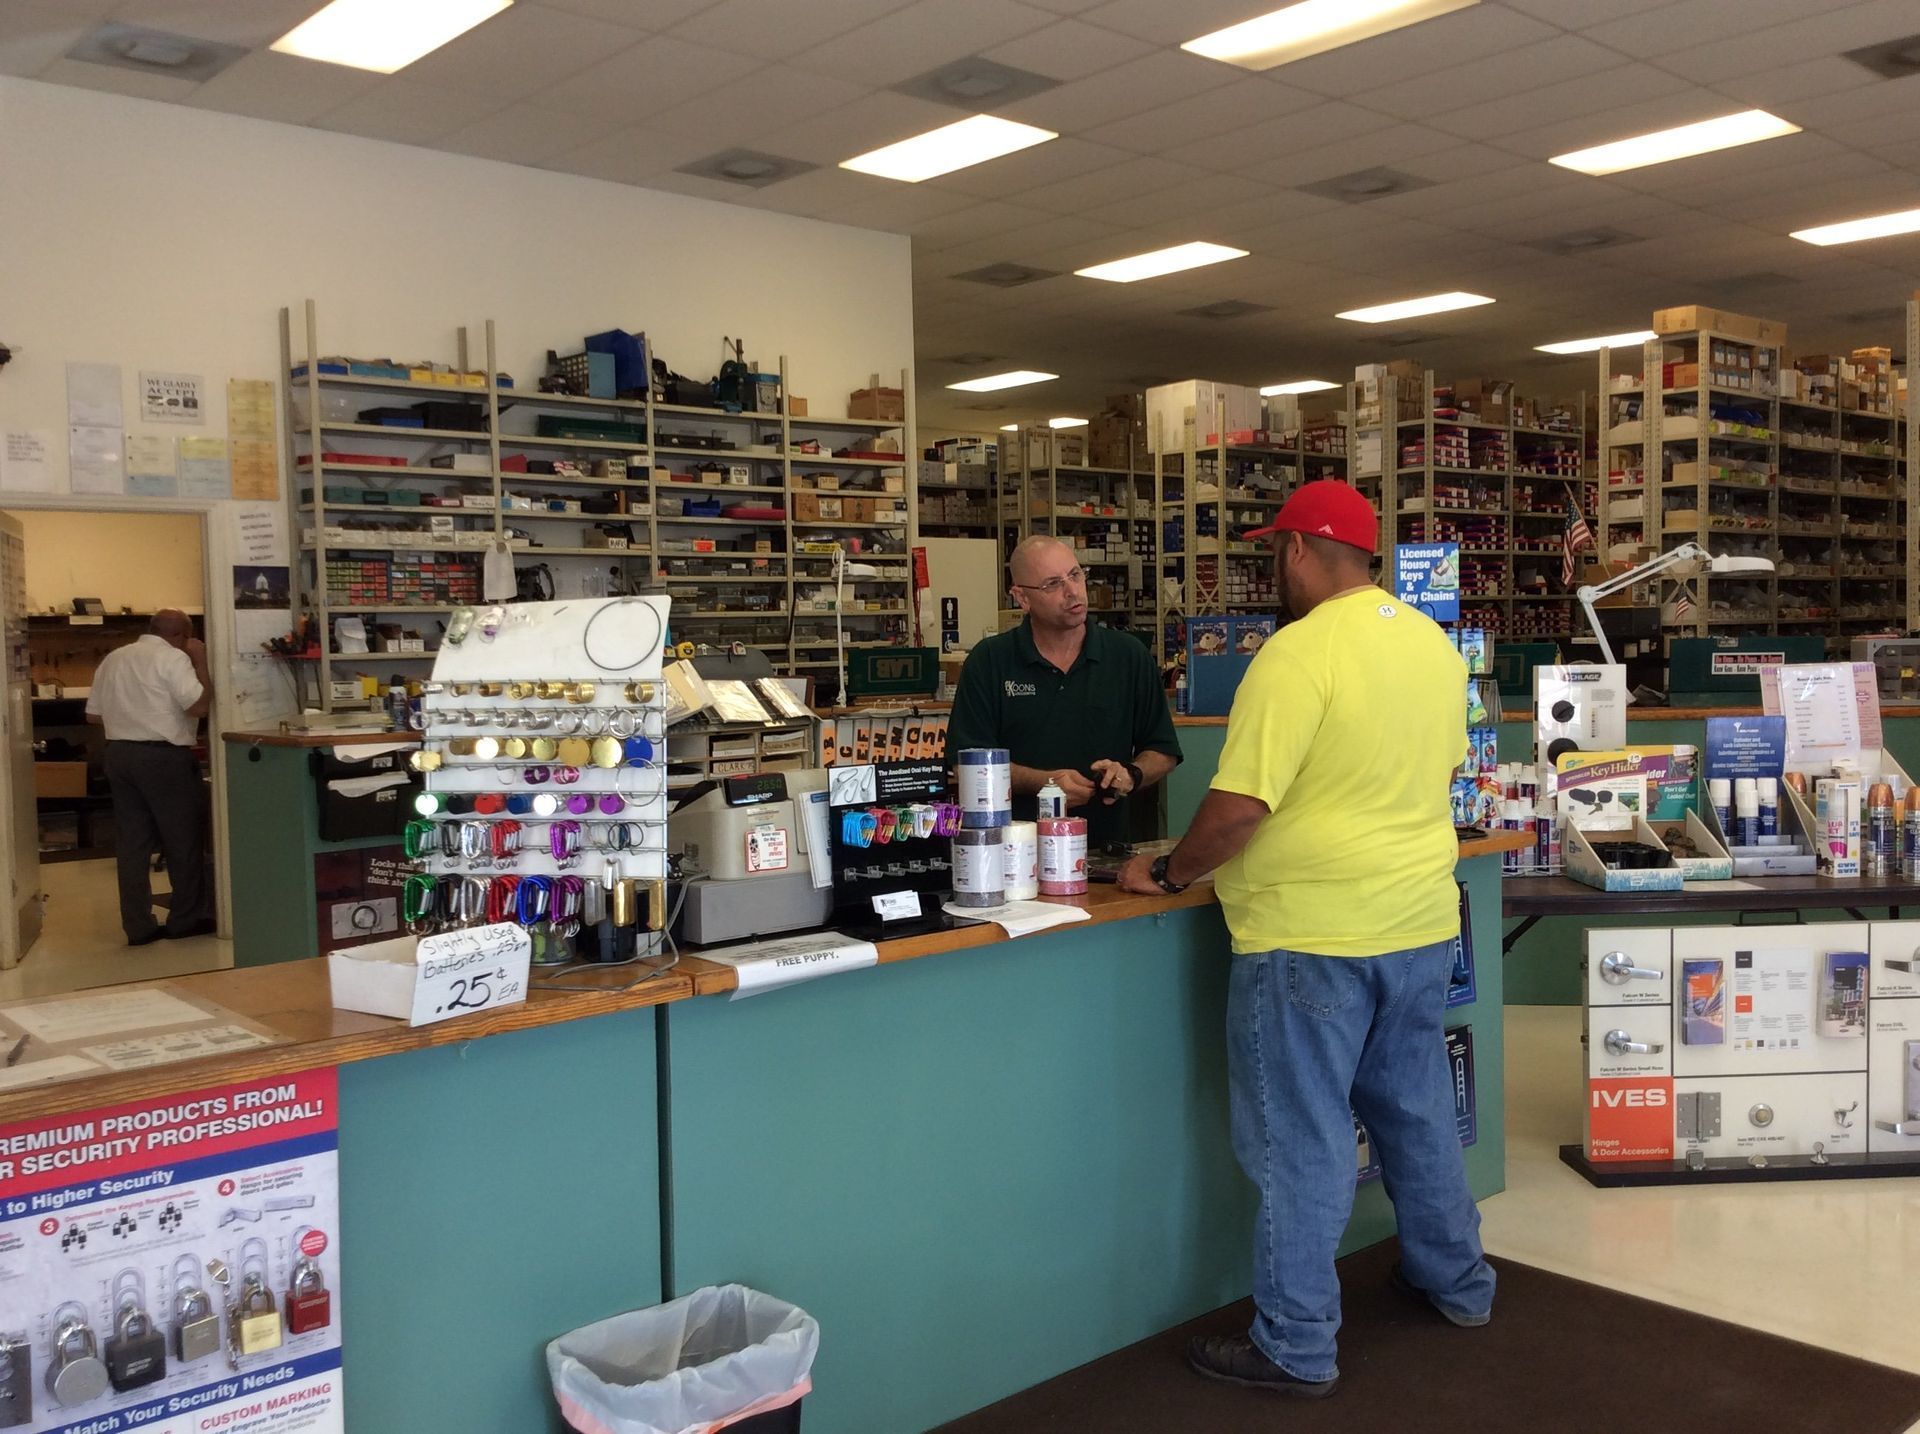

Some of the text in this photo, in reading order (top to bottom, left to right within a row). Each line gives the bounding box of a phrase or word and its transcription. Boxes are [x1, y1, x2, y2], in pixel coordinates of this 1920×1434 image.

[1400, 547, 1444, 559] Licensed
[1400, 560, 1431, 570] House
[1400, 571, 1424, 582] Keys
[1406, 581, 1414, 591] &
[1400, 591, 1455, 603] Key Chains
[1590, 761, 1641, 778] Key Hider
[371, 858, 396, 868] Locks
[367, 876, 389, 886] think
[423, 925, 517, 956] Slightly Used
[423, 952, 486, 979] Batteries
[776, 951, 839, 967] FREE PUPPY.
[497, 982, 519, 1001] EA
[1592, 1088, 1667, 1108] IVES
[0, 1083, 296, 1157] REMIUM PRODUCTS FROM
[21, 1136, 142, 1176] SECURITY
[147, 1099, 323, 1150] PROFESSIONAL!
[1592, 1139, 1620, 1147] Hinges
[1600, 1148, 1619, 1156] Door
[1621, 1147, 1669, 1156] Accessories
[6, 1171, 174, 1215] to Higher Security
[222, 1182, 231, 1193] 4
[45, 1222, 54, 1231] 3
[64, 1366, 295, 1434] Match Your Security Needs
[200, 1382, 332, 1430] CUSTOM MARKING
